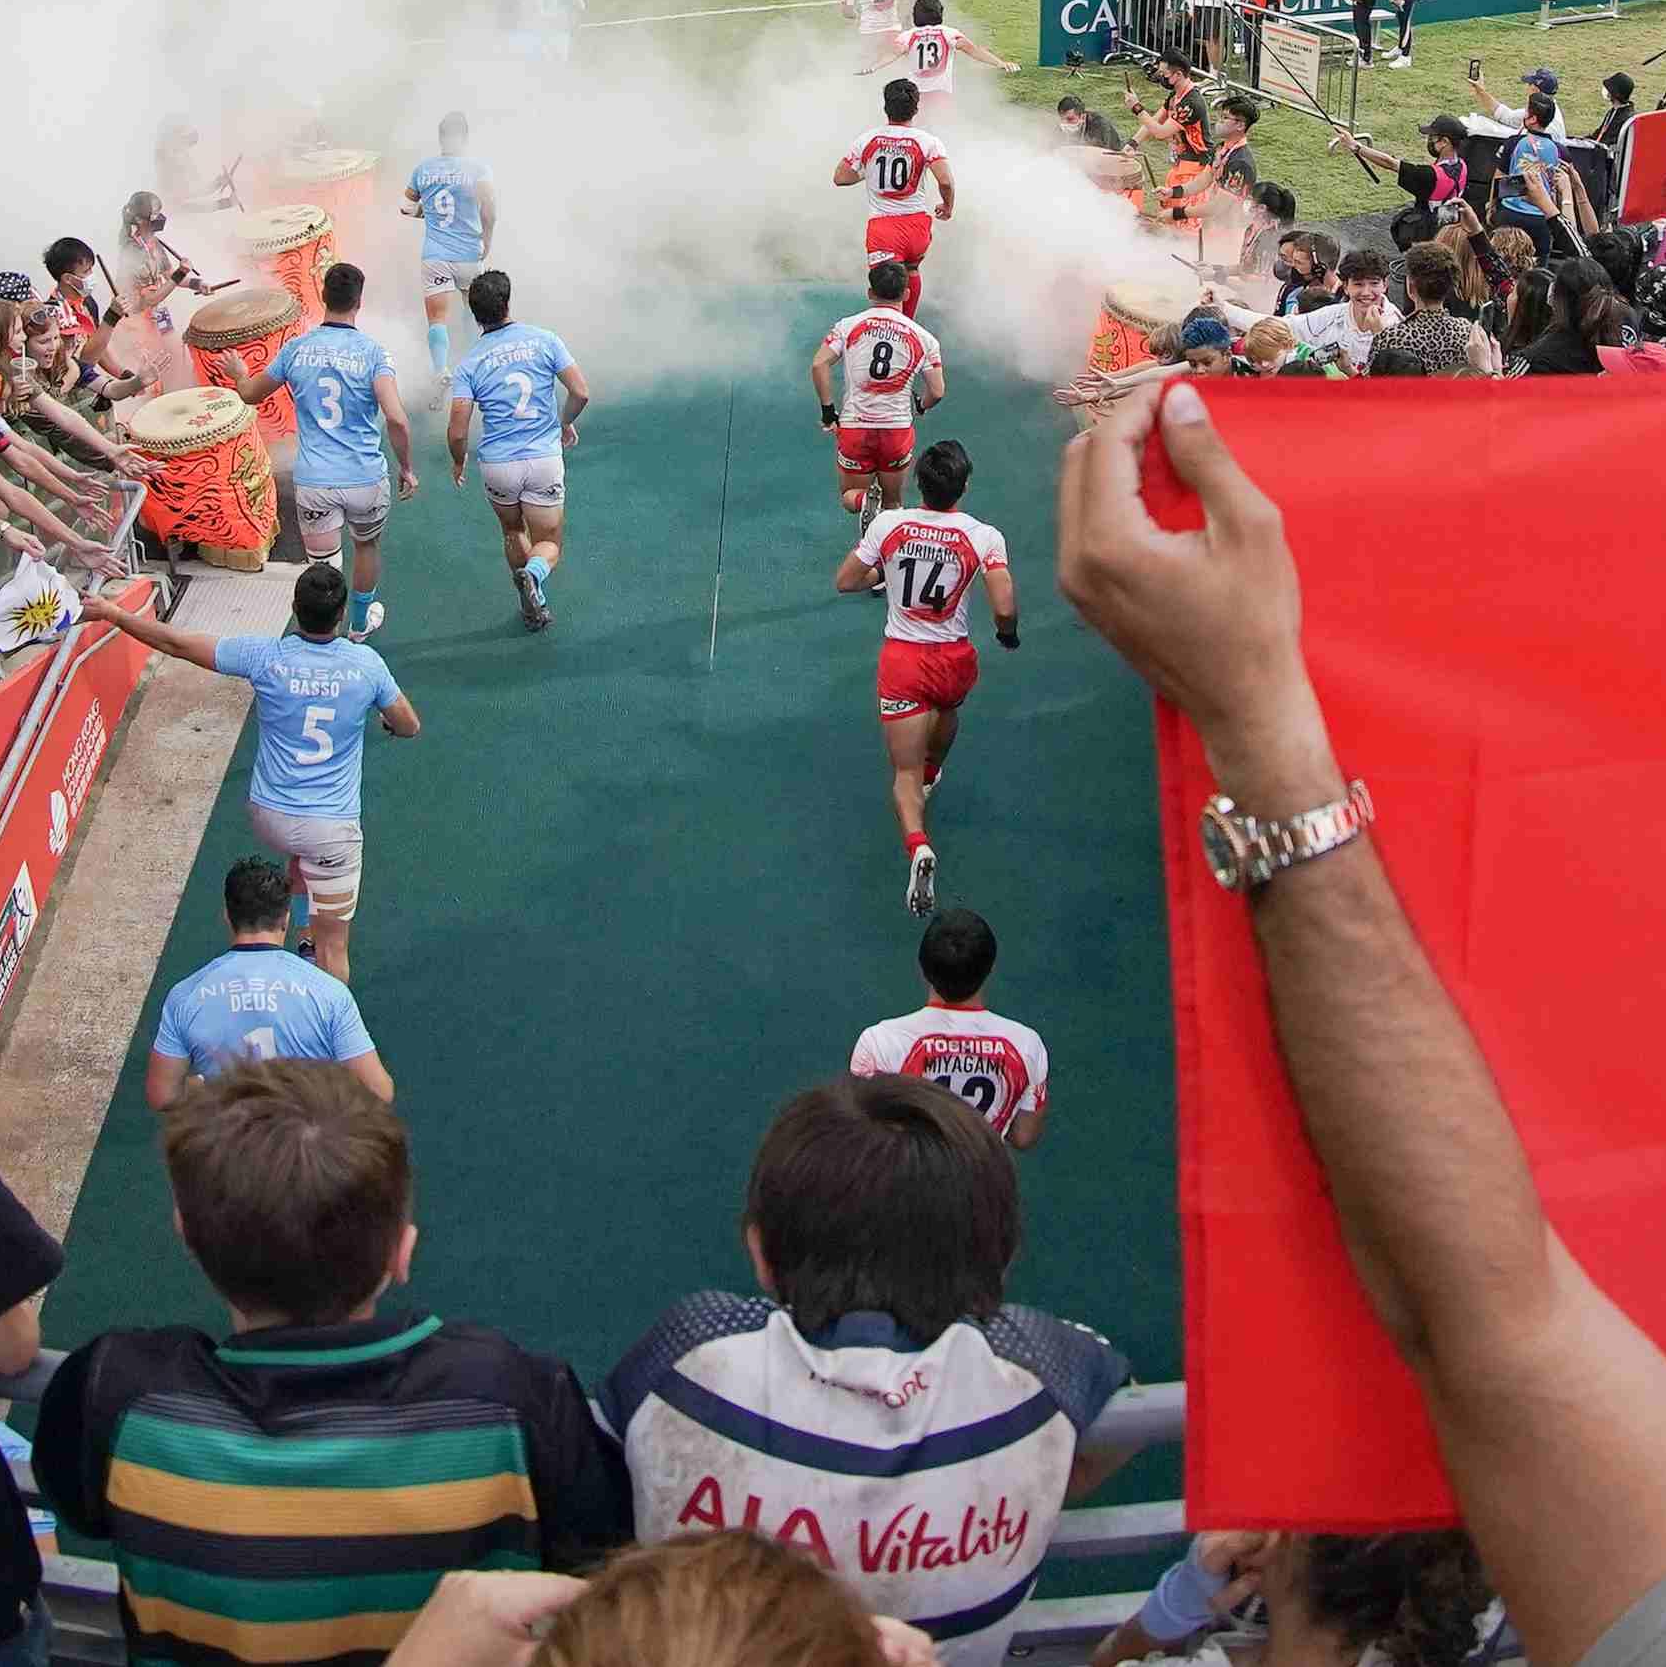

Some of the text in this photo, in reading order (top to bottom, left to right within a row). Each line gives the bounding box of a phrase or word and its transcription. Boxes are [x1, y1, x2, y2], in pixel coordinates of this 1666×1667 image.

[917, 42, 939, 70] 13
[876, 155, 908, 191] 10
[435, 188, 455, 228] 9
[866, 318, 909, 334] TOSHIBA
[869, 341, 894, 381] 8
[317, 376, 343, 430] 3
[504, 371, 539, 420] 2
[901, 524, 960, 543] TOSHIBA
[899, 557, 947, 613] 14
[273, 665, 361, 682] NISSAN
[290, 679, 340, 699] BASSO
[62, 736, 84, 786] HONG
[80, 697, 101, 738] KONG
[296, 705, 336, 765] 5
[201, 976, 307, 999] NISSAN
[229, 992, 278, 1013] DEUS
[925, 1038, 1006, 1055] TOSHIBA
[924, 1053, 1005, 1075] MIYAGAMI
[857, 1494, 1029, 1575] Vitality
